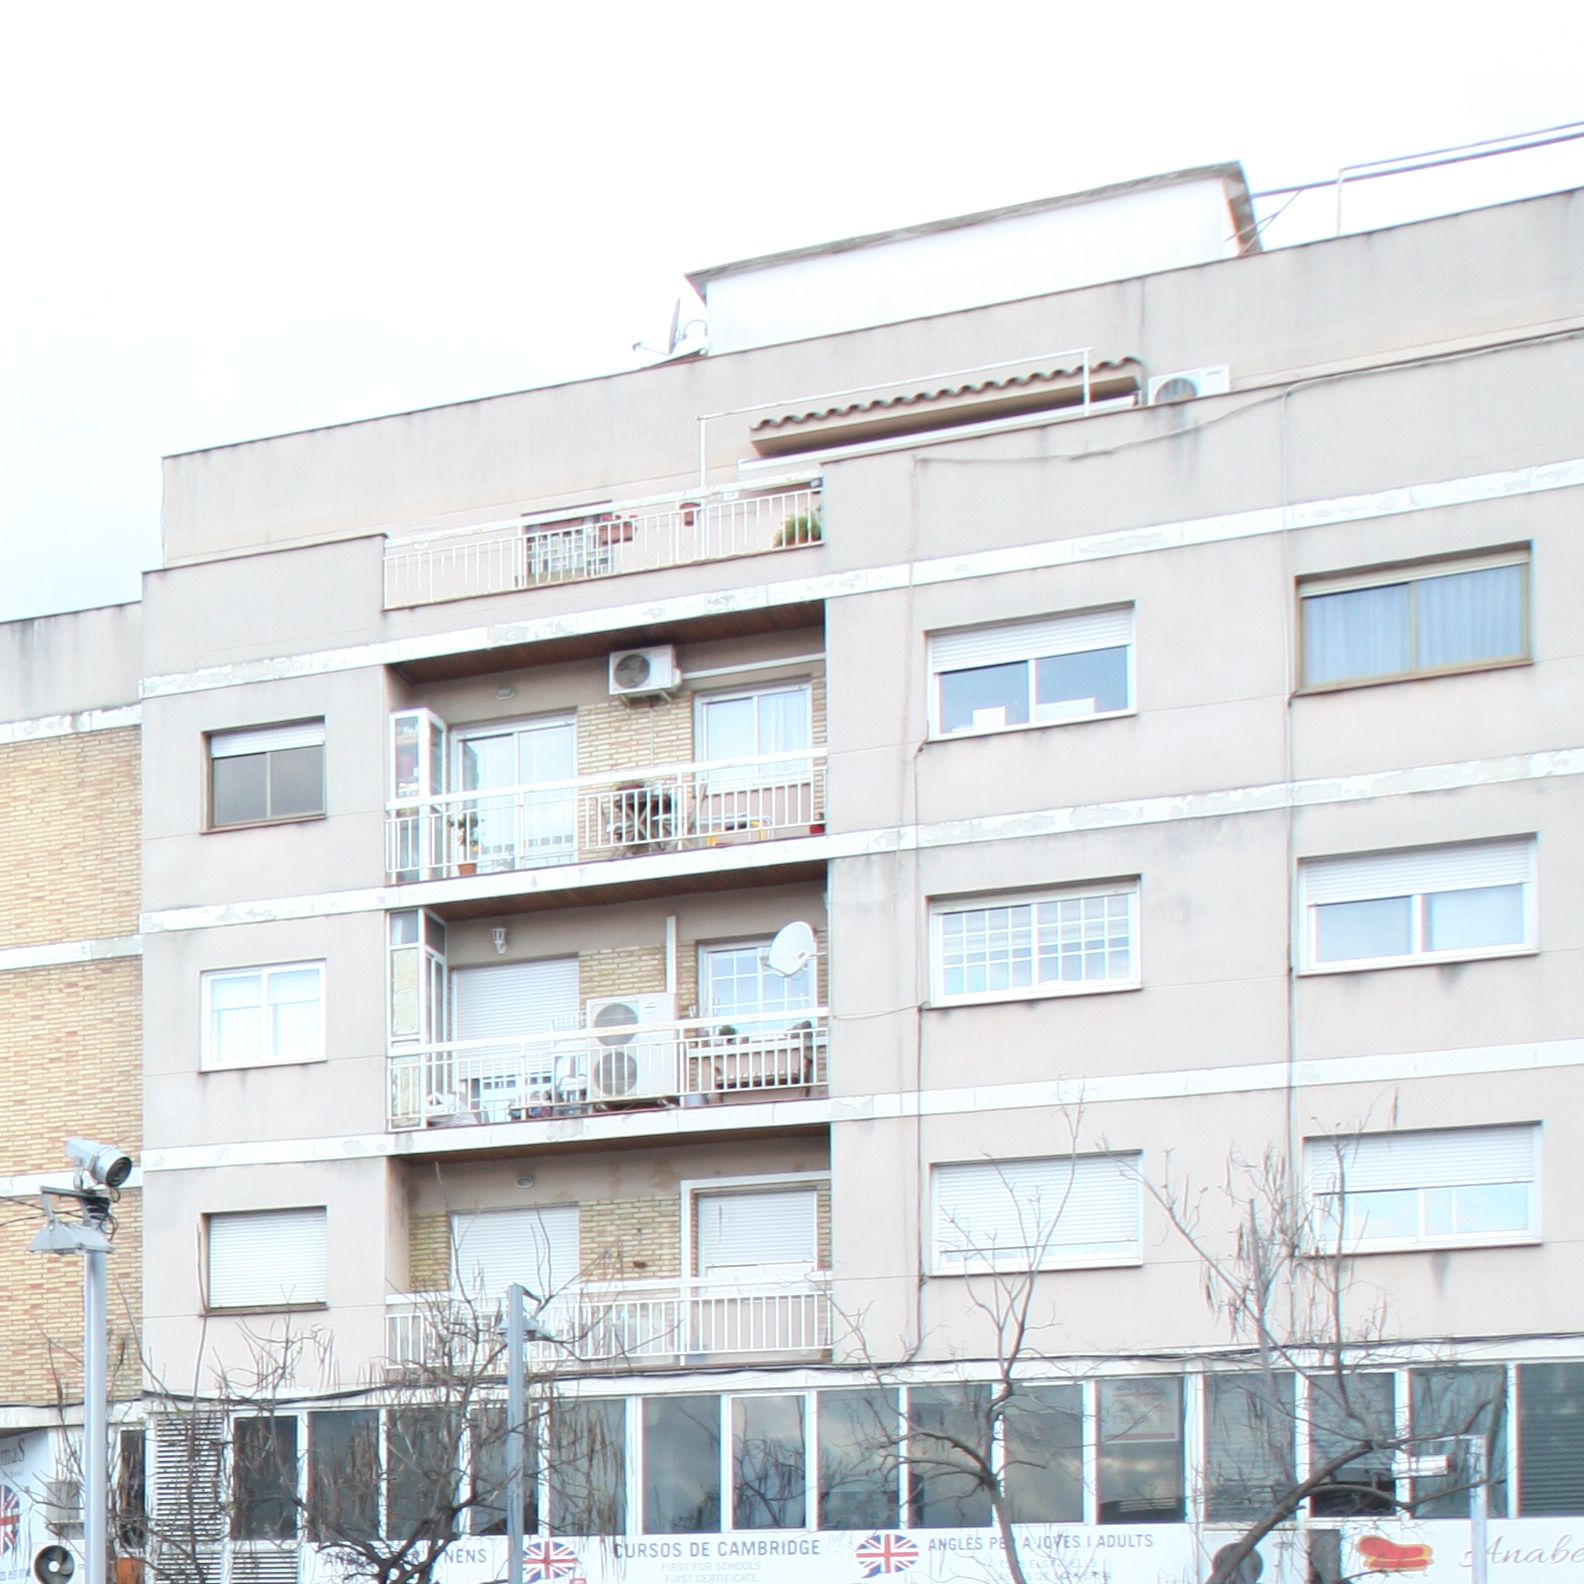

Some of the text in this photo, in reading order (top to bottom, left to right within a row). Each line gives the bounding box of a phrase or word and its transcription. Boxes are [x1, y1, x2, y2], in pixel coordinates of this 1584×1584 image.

[615, 1539, 821, 1559] CURSOS DE CAMBRIDGE
[928, 1535, 983, 1551] ANGLÈS
[990, 1537, 1014, 1550] PE
[1022, 1536, 1031, 1549] A
[1098, 1533, 1154, 1548] ADULTS
[444, 1548, 487, 1564] NENS
